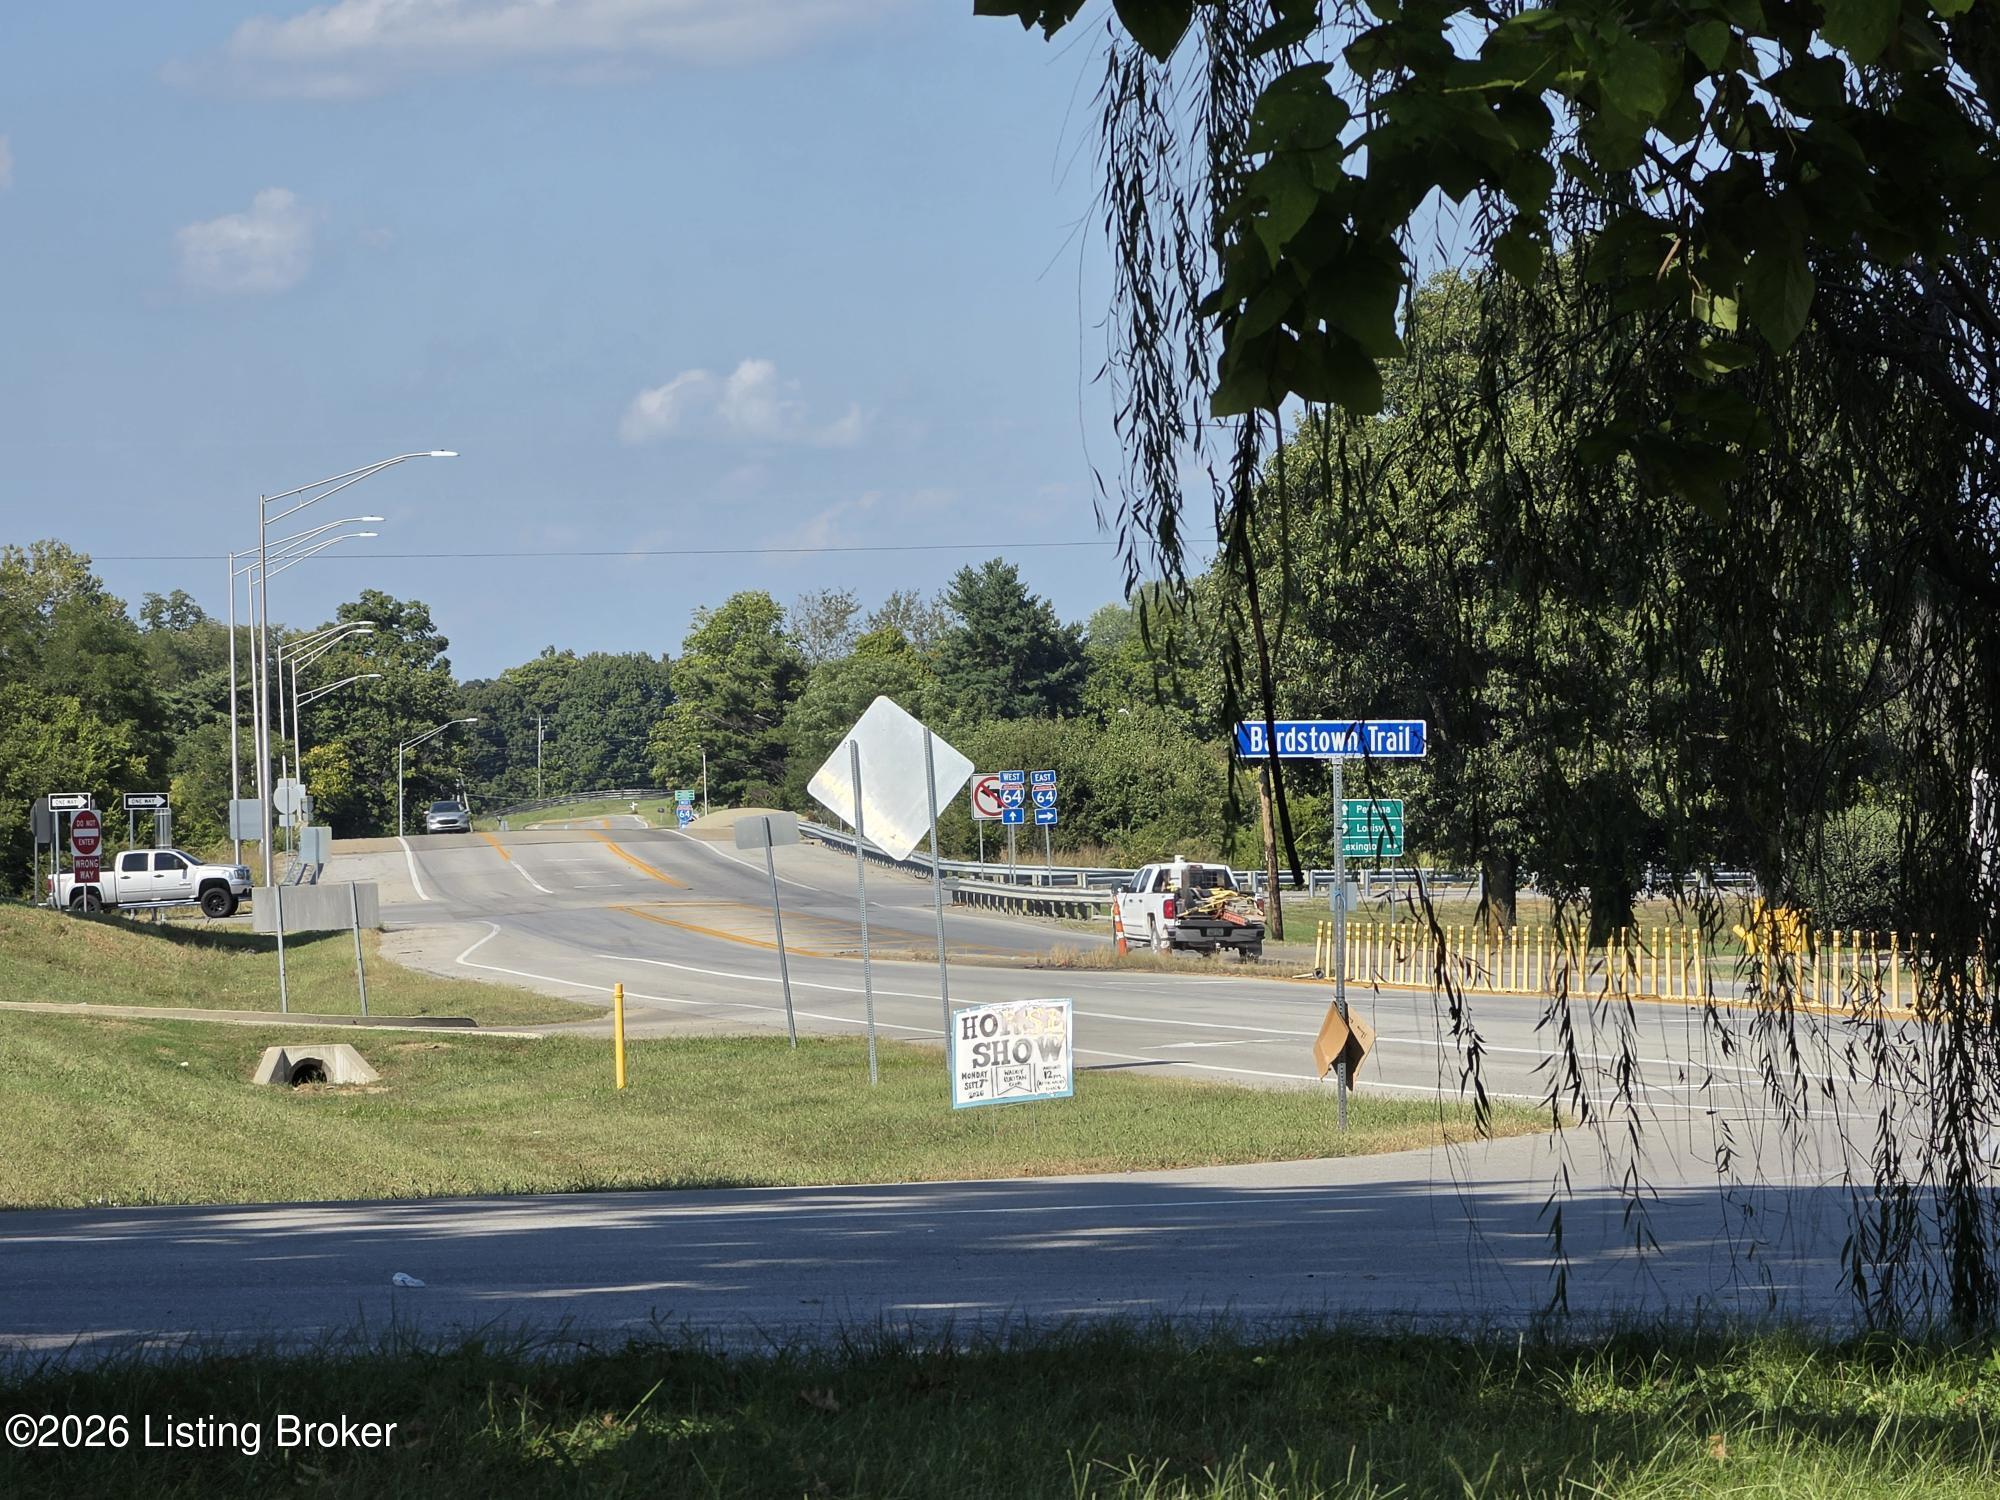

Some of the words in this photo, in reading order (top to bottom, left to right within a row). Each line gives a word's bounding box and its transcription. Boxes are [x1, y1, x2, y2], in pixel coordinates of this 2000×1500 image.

[1367, 725, 1410, 752] Trail
[1003, 773, 1020, 781] WEST
[1035, 773, 1051, 782] EAST
[1003, 790, 1021, 803] 64
[1036, 791, 1053, 803] 64
[1356, 804, 1391, 814] Petona
[76, 819, 84, 827] DO
[86, 819, 96, 827] NOT
[1356, 823, 1397, 833] Loisve
[78, 838, 95, 846] ENTER
[1342, 841, 1379, 853] exingto
[75, 859, 99, 869] WRONG
[80, 870, 95, 880] WAY
[962, 1007, 1064, 1040] HORSE
[972, 1036, 1064, 1069] SHOW
[961, 1070, 988, 1080] MONDAY
